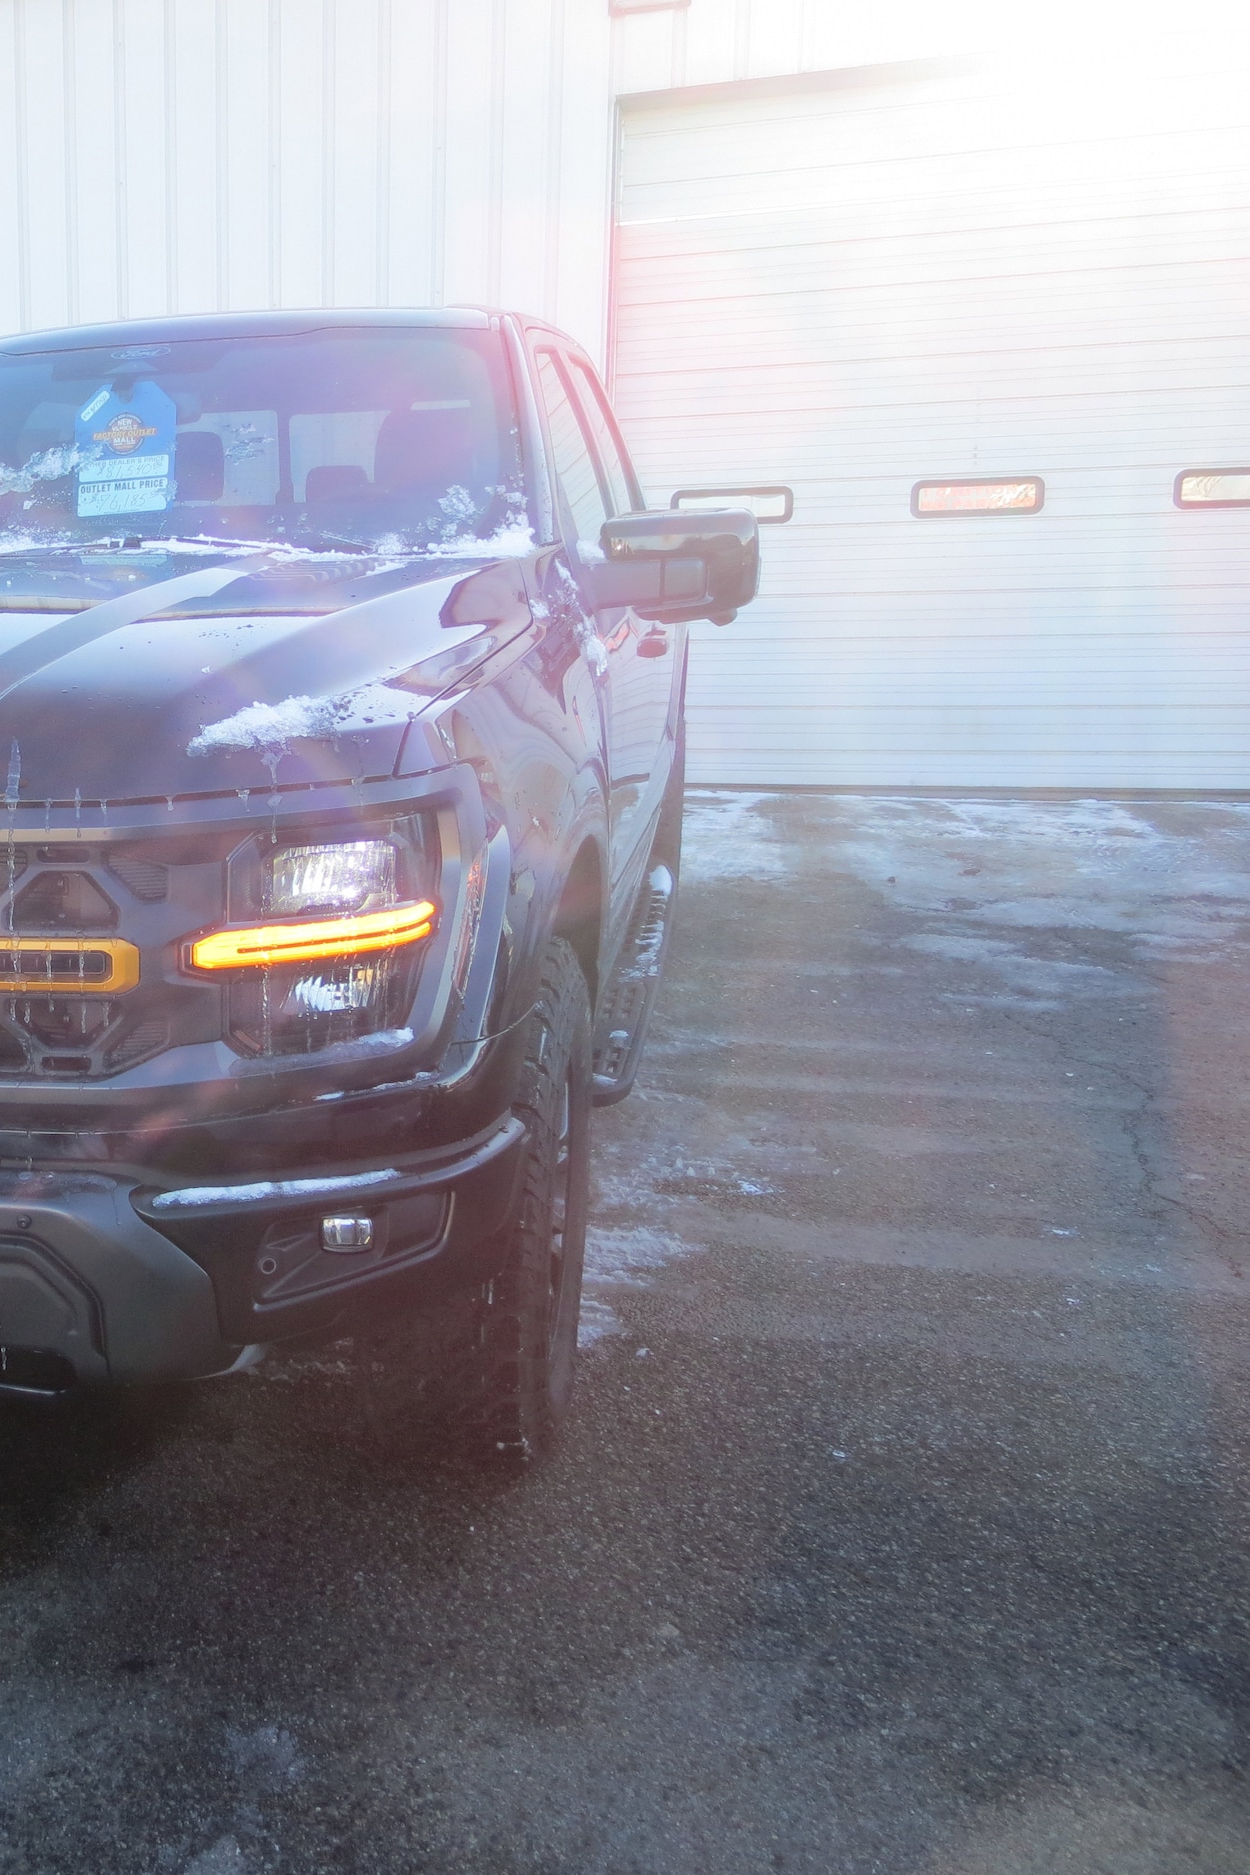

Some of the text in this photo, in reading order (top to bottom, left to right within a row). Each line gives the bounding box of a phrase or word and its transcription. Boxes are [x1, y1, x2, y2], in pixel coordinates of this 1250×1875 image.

[117, 418, 133, 426] NEW
[93, 427, 157, 440] FACTORY OUTLET
[143, 454, 165, 463] PRICE
[80, 478, 165, 494] OUTLET MALL PRICE
